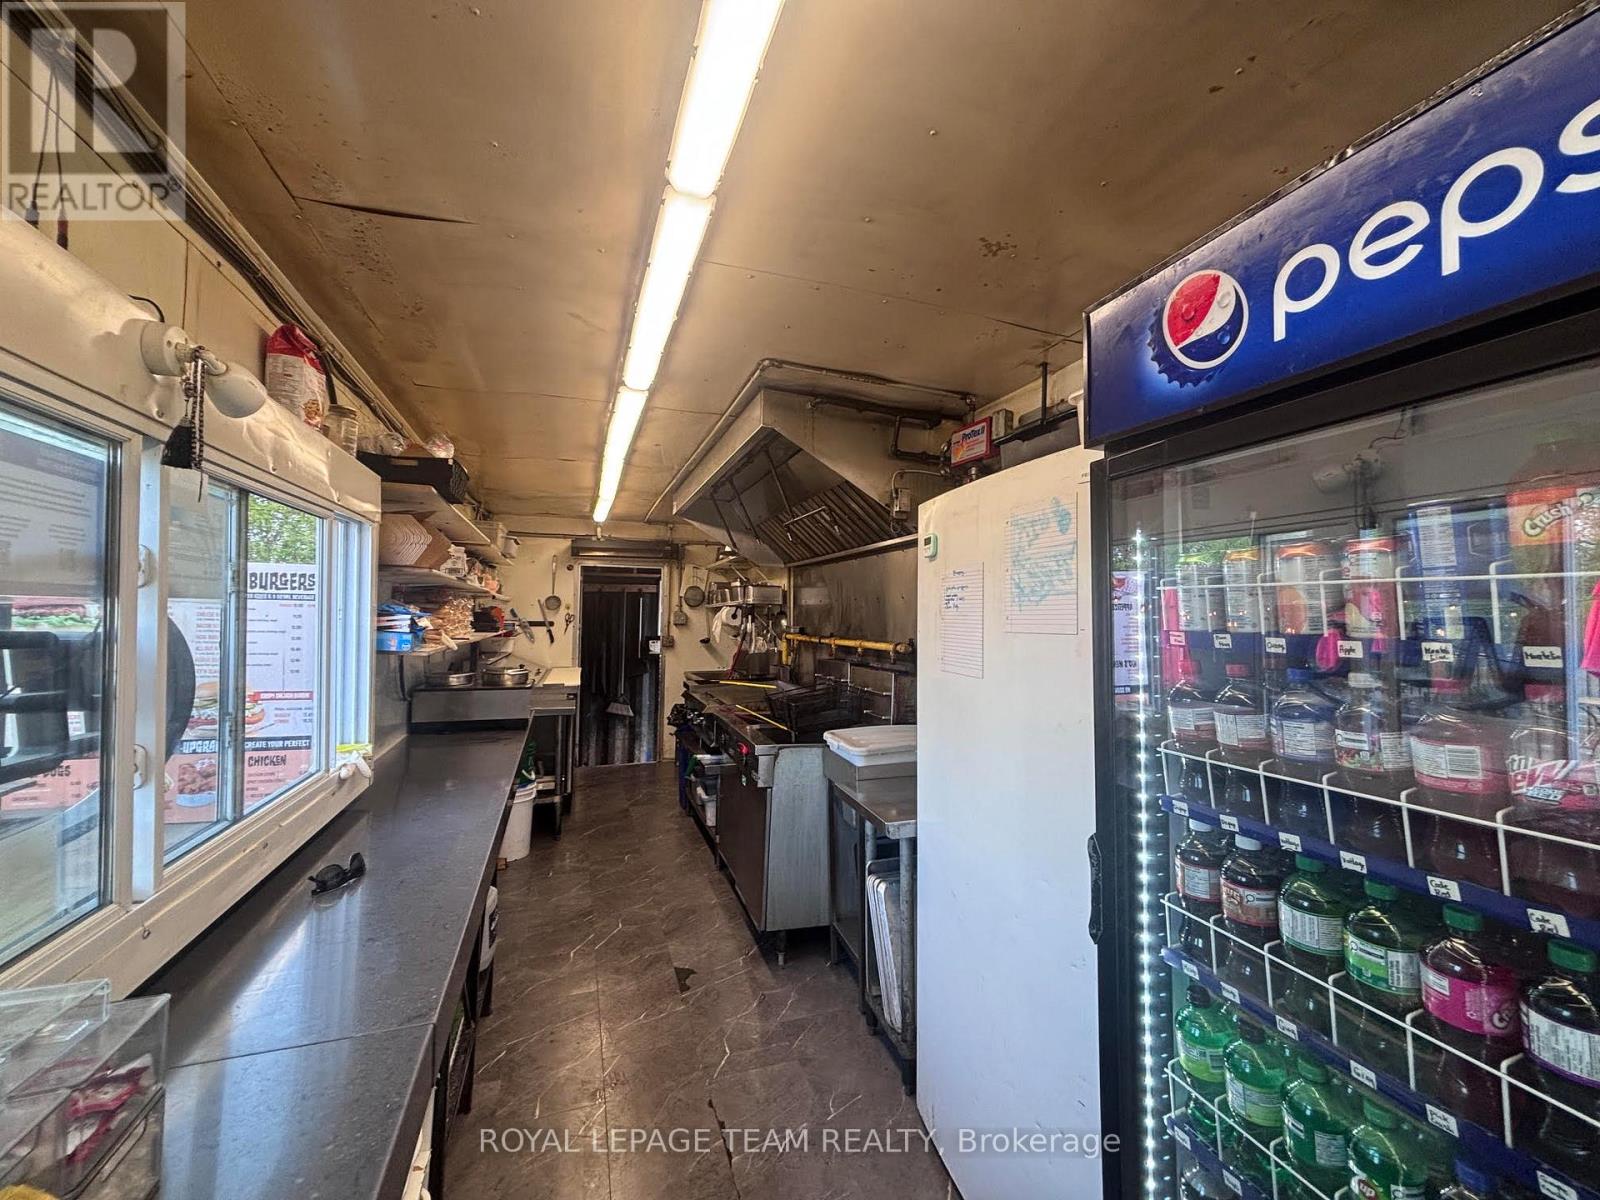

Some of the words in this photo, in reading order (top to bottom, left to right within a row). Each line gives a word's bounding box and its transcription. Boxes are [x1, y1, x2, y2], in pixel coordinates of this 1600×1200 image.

[1522, 502, 1573, 538] Crush
[249, 572, 316, 591] BURGERS
[267, 740, 283, 748] YOUR
[284, 739, 310, 748] PERFECT
[248, 754, 287, 767] CHICKEN
